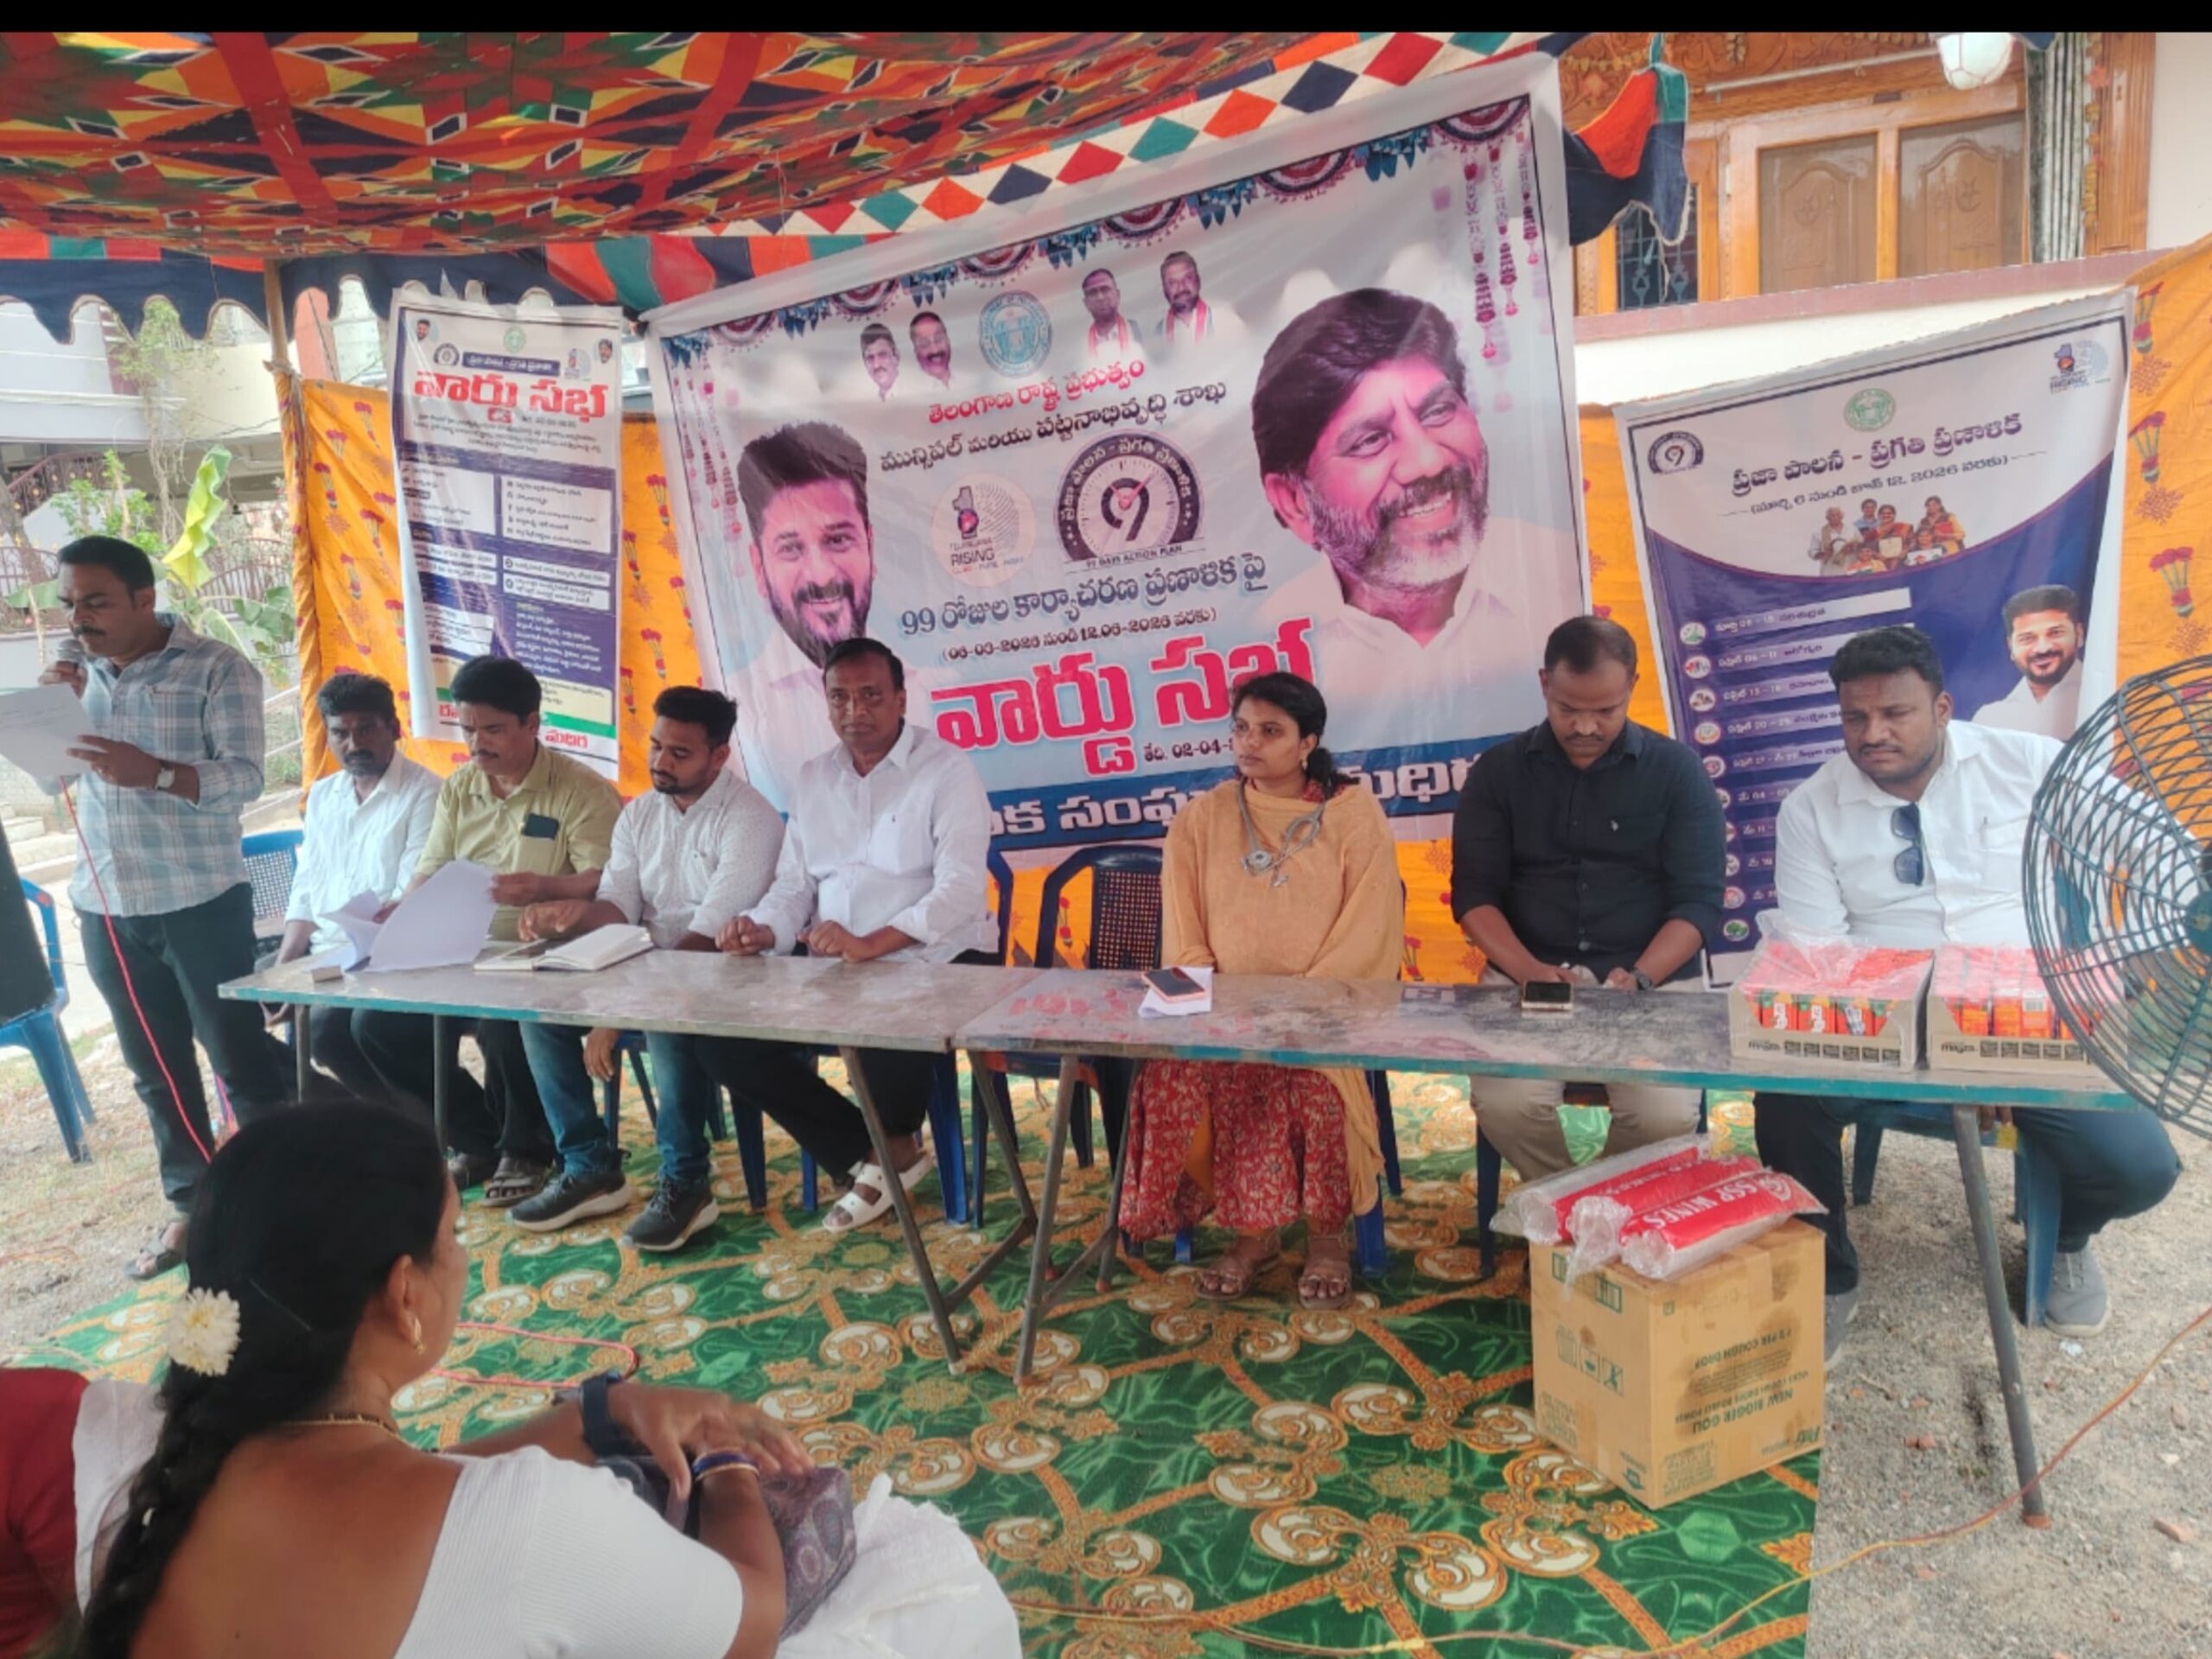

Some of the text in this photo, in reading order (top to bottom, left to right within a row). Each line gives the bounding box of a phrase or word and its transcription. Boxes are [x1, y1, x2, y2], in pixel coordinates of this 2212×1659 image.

[414, 371, 608, 423] వార్డు సభ
[929, 392, 1014, 424] తెలంగాణ
[1065, 359, 1145, 401] ప్రభుత్వం
[968, 428, 1033, 454] మరియు
[1173, 382, 1226, 406] శాఖ
[1732, 468, 1777, 498] ప్రజా
[1783, 449, 1844, 480] పాలన
[1869, 436, 1926, 469] ప్రగతి
[951, 548, 995, 567] RISING
[901, 607, 936, 635] 99
[941, 595, 1009, 629] రోజుల
[1241, 552, 1268, 592] పై
[931, 652, 1135, 776] వార్డు
[1057, 786, 1205, 830] సంఘ
[1767, 1388, 1794, 1408] NEW
